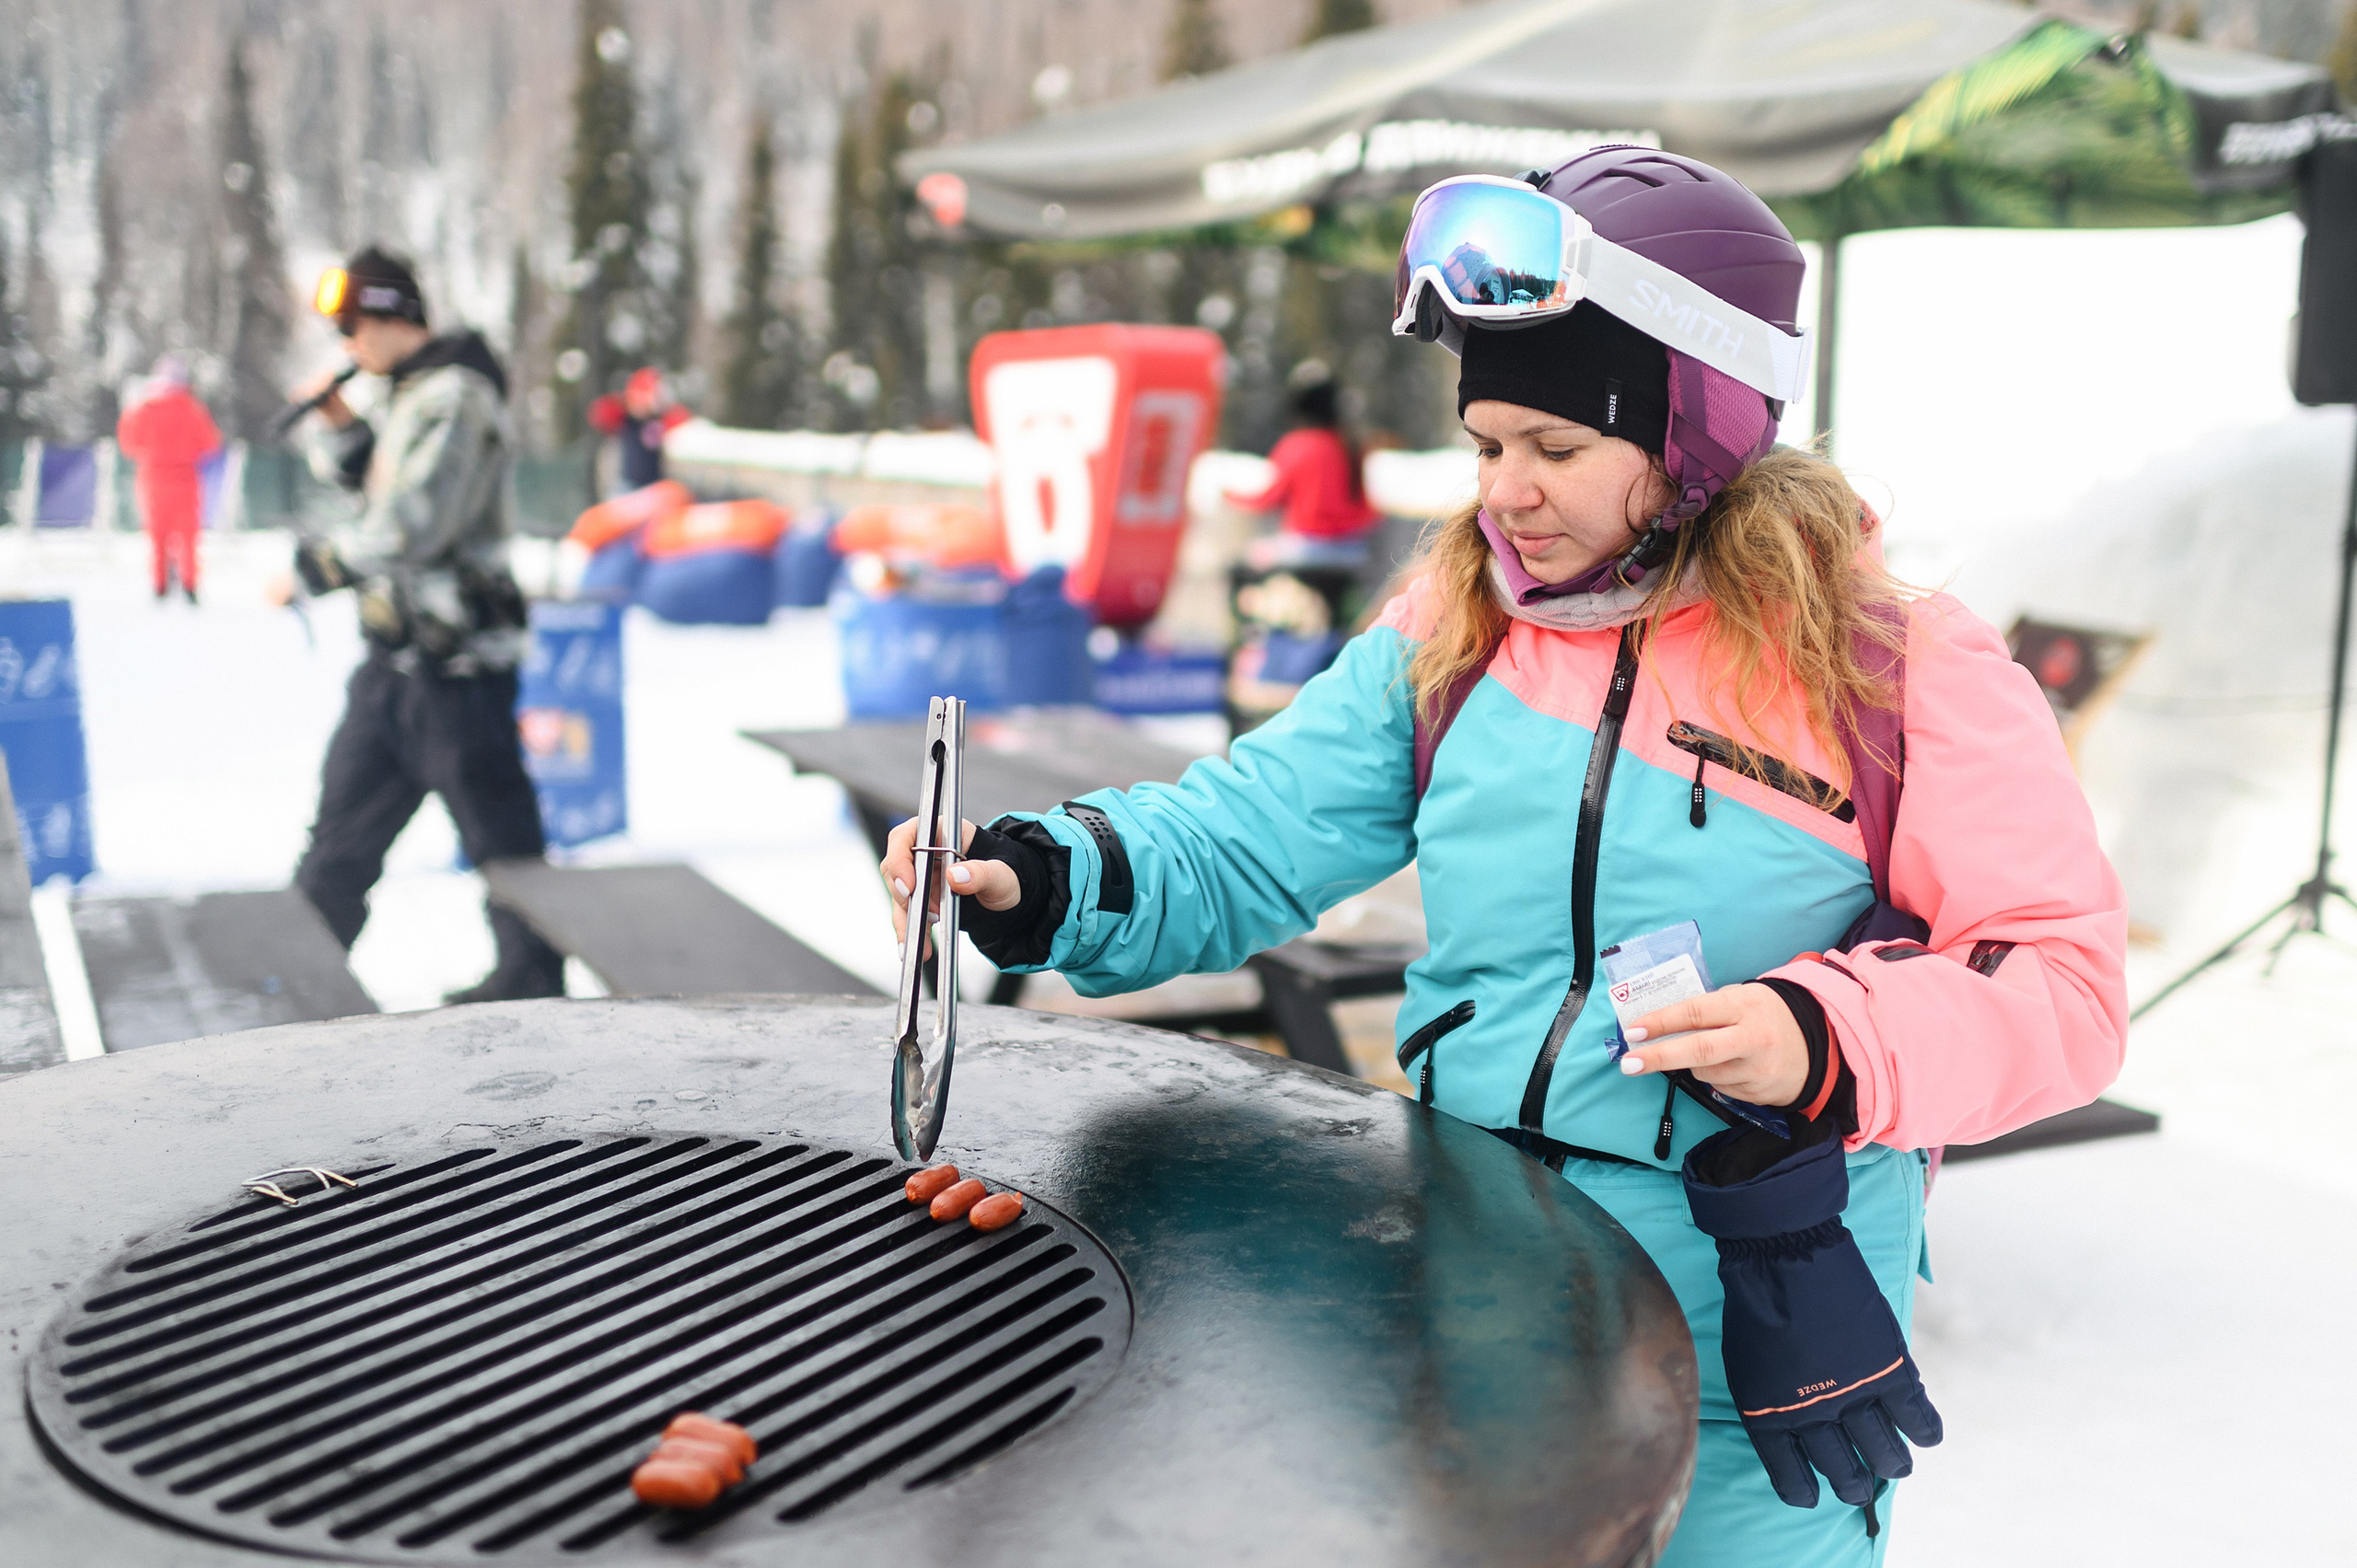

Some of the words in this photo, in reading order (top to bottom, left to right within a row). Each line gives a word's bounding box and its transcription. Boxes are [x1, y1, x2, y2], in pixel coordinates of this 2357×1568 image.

[1629, 278, 1746, 358] SMITH
[1608, 393, 1618, 424] WEDZE
[1796, 1378, 1838, 1397] WEDZE
